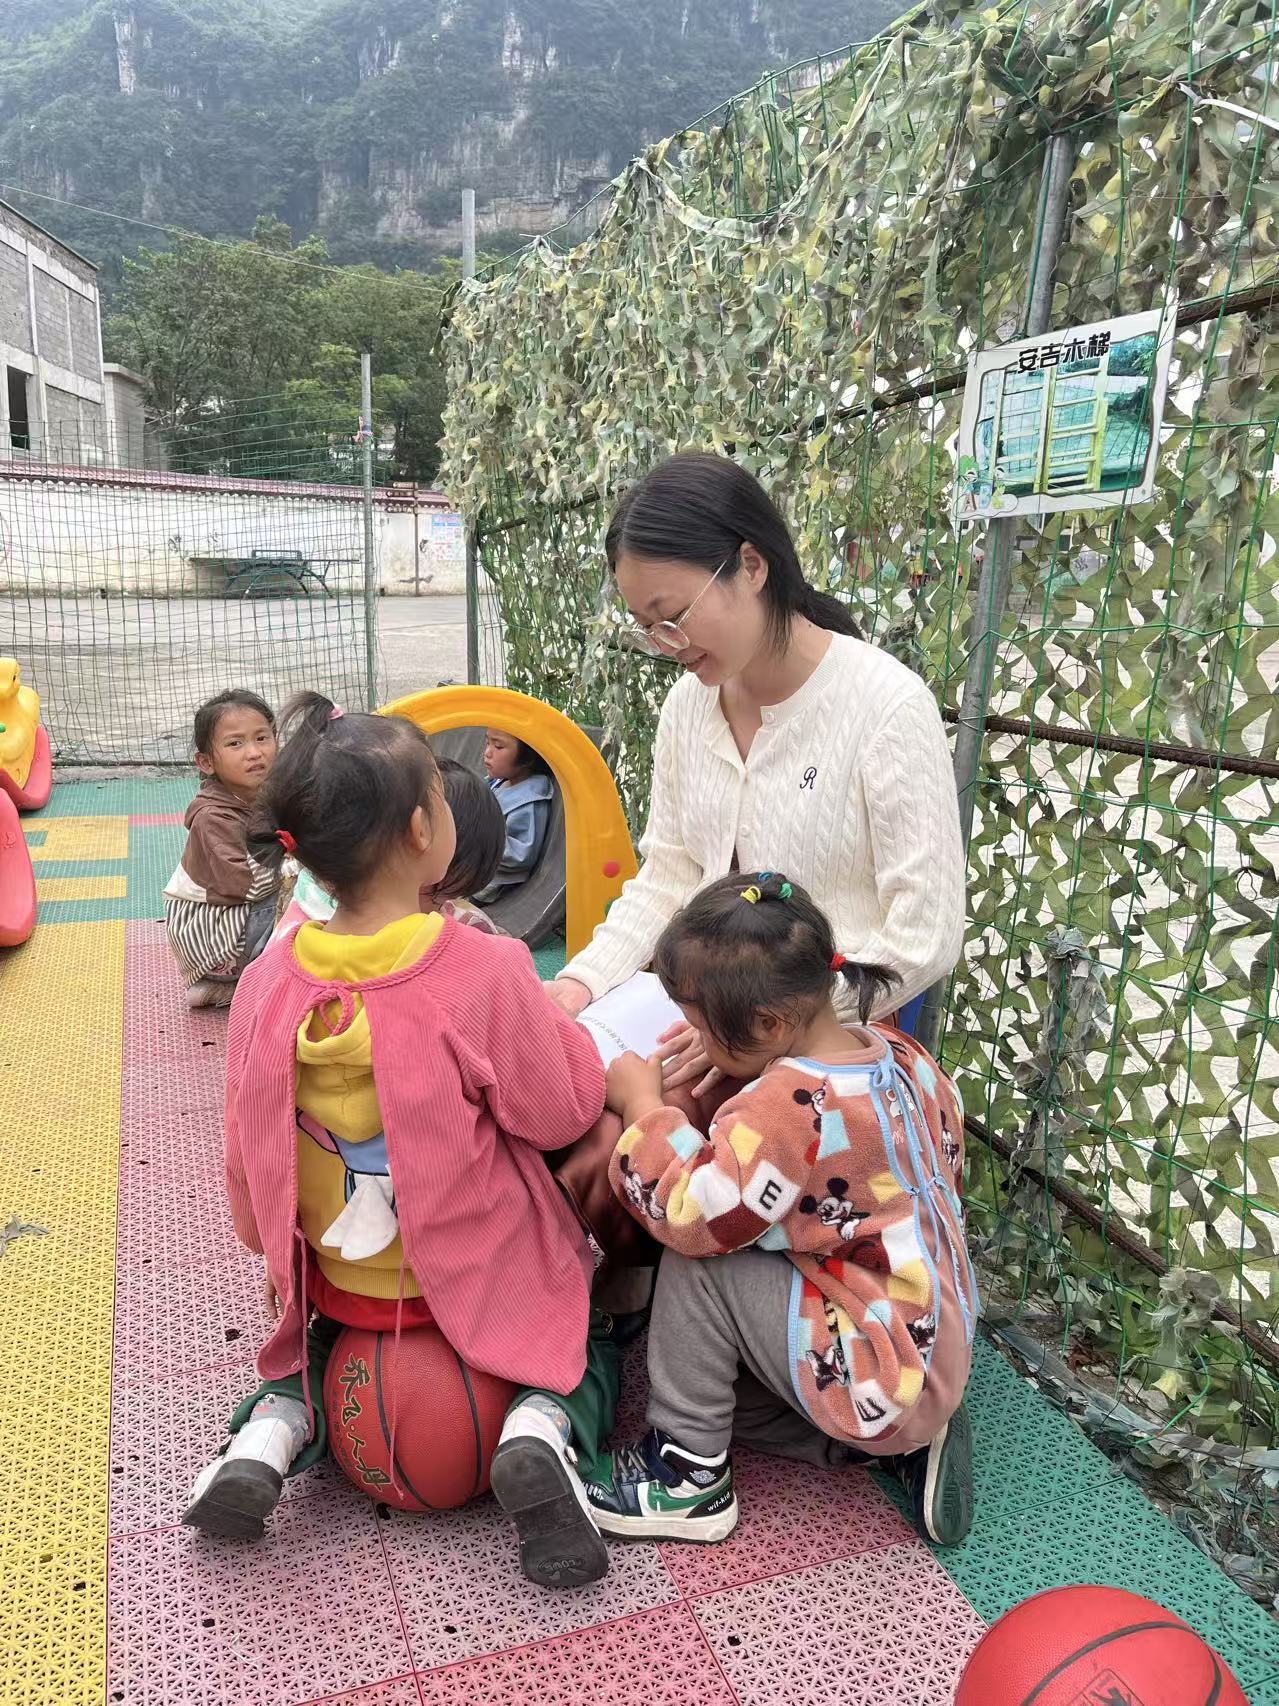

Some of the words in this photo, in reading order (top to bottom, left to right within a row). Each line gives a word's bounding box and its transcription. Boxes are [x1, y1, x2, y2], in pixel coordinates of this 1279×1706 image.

[1018, 330, 1111, 374] 安吉木梯
[799, 766, 817, 790] R
[759, 1179, 782, 1211] E
